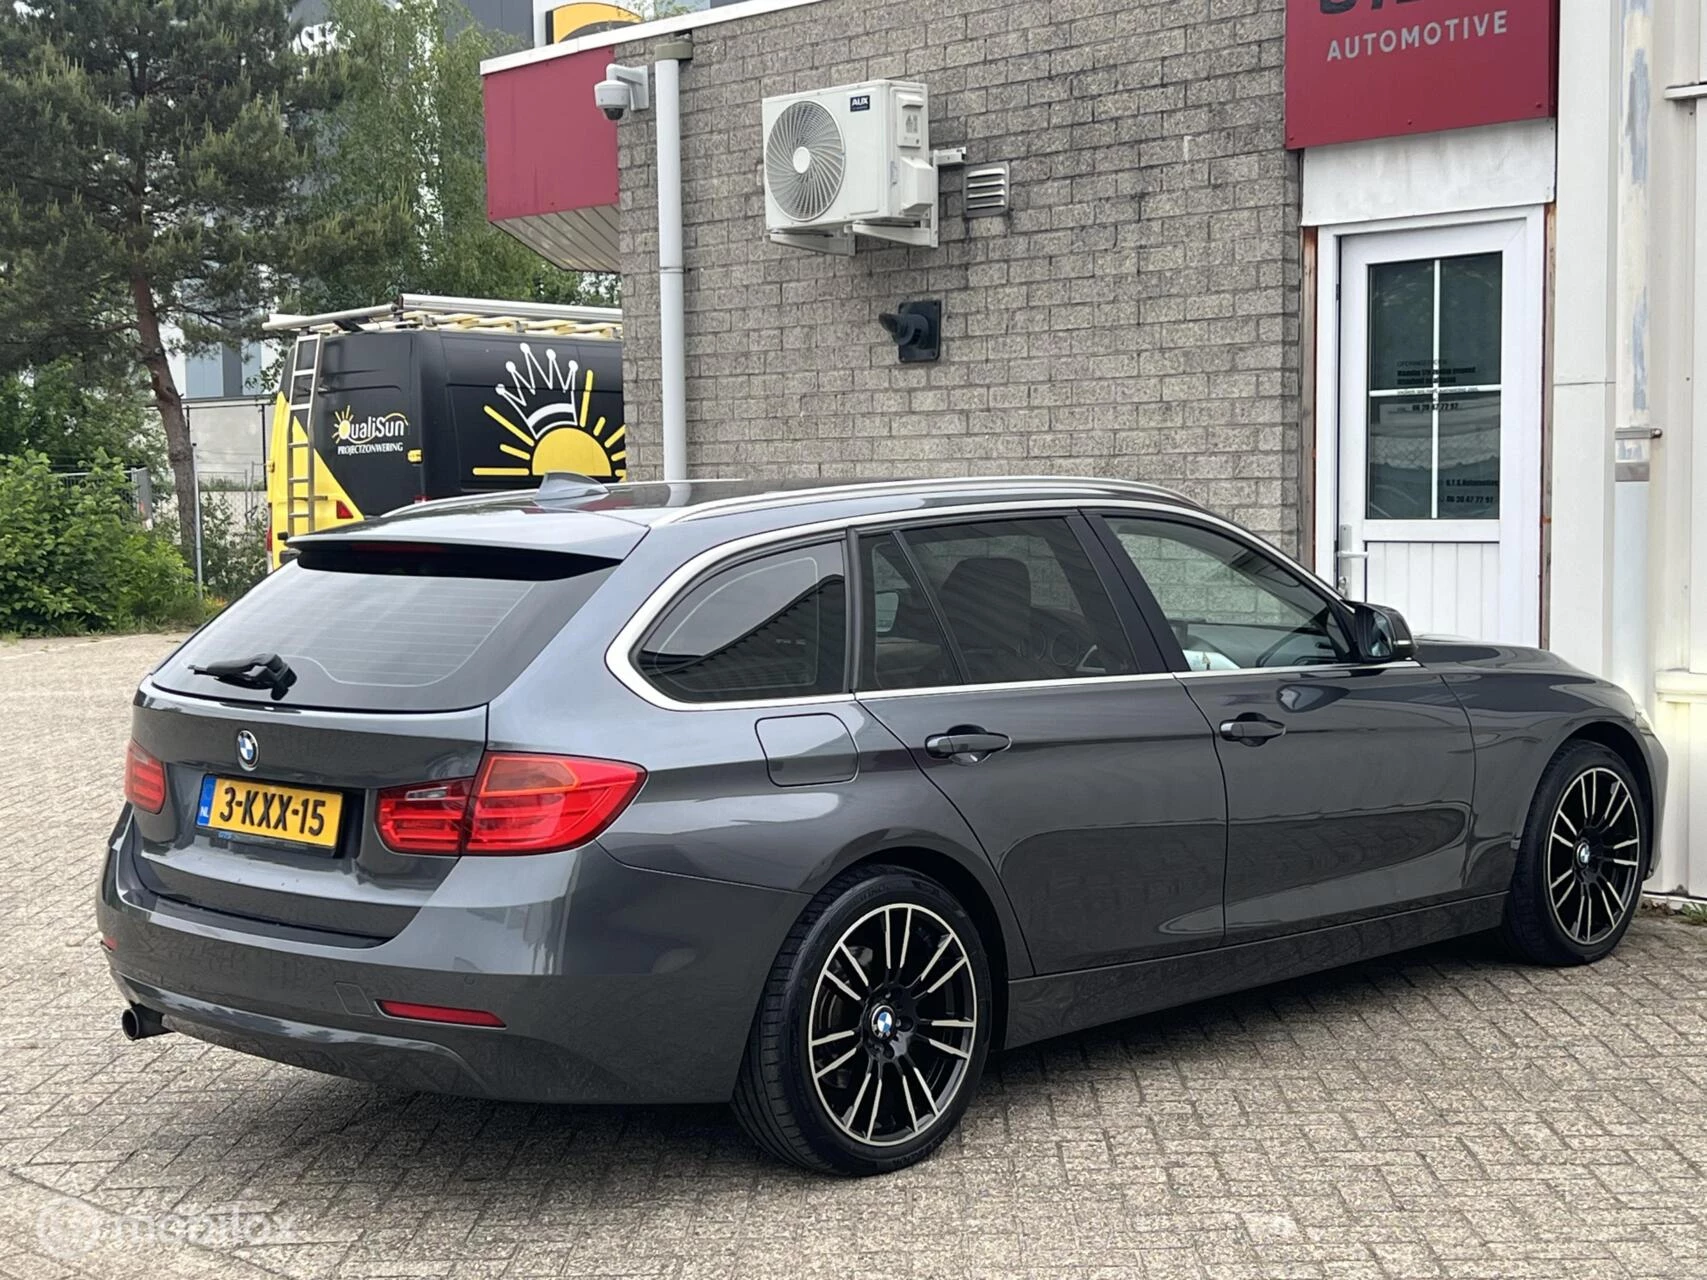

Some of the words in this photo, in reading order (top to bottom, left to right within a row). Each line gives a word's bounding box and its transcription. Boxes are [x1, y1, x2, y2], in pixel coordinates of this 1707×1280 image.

[1327, 10, 1508, 62] AUTOMOTIVE
[851, 97, 869, 106] AUX
[200, 806, 209, 818] NL
[219, 787, 326, 836] 3-KXX-15
